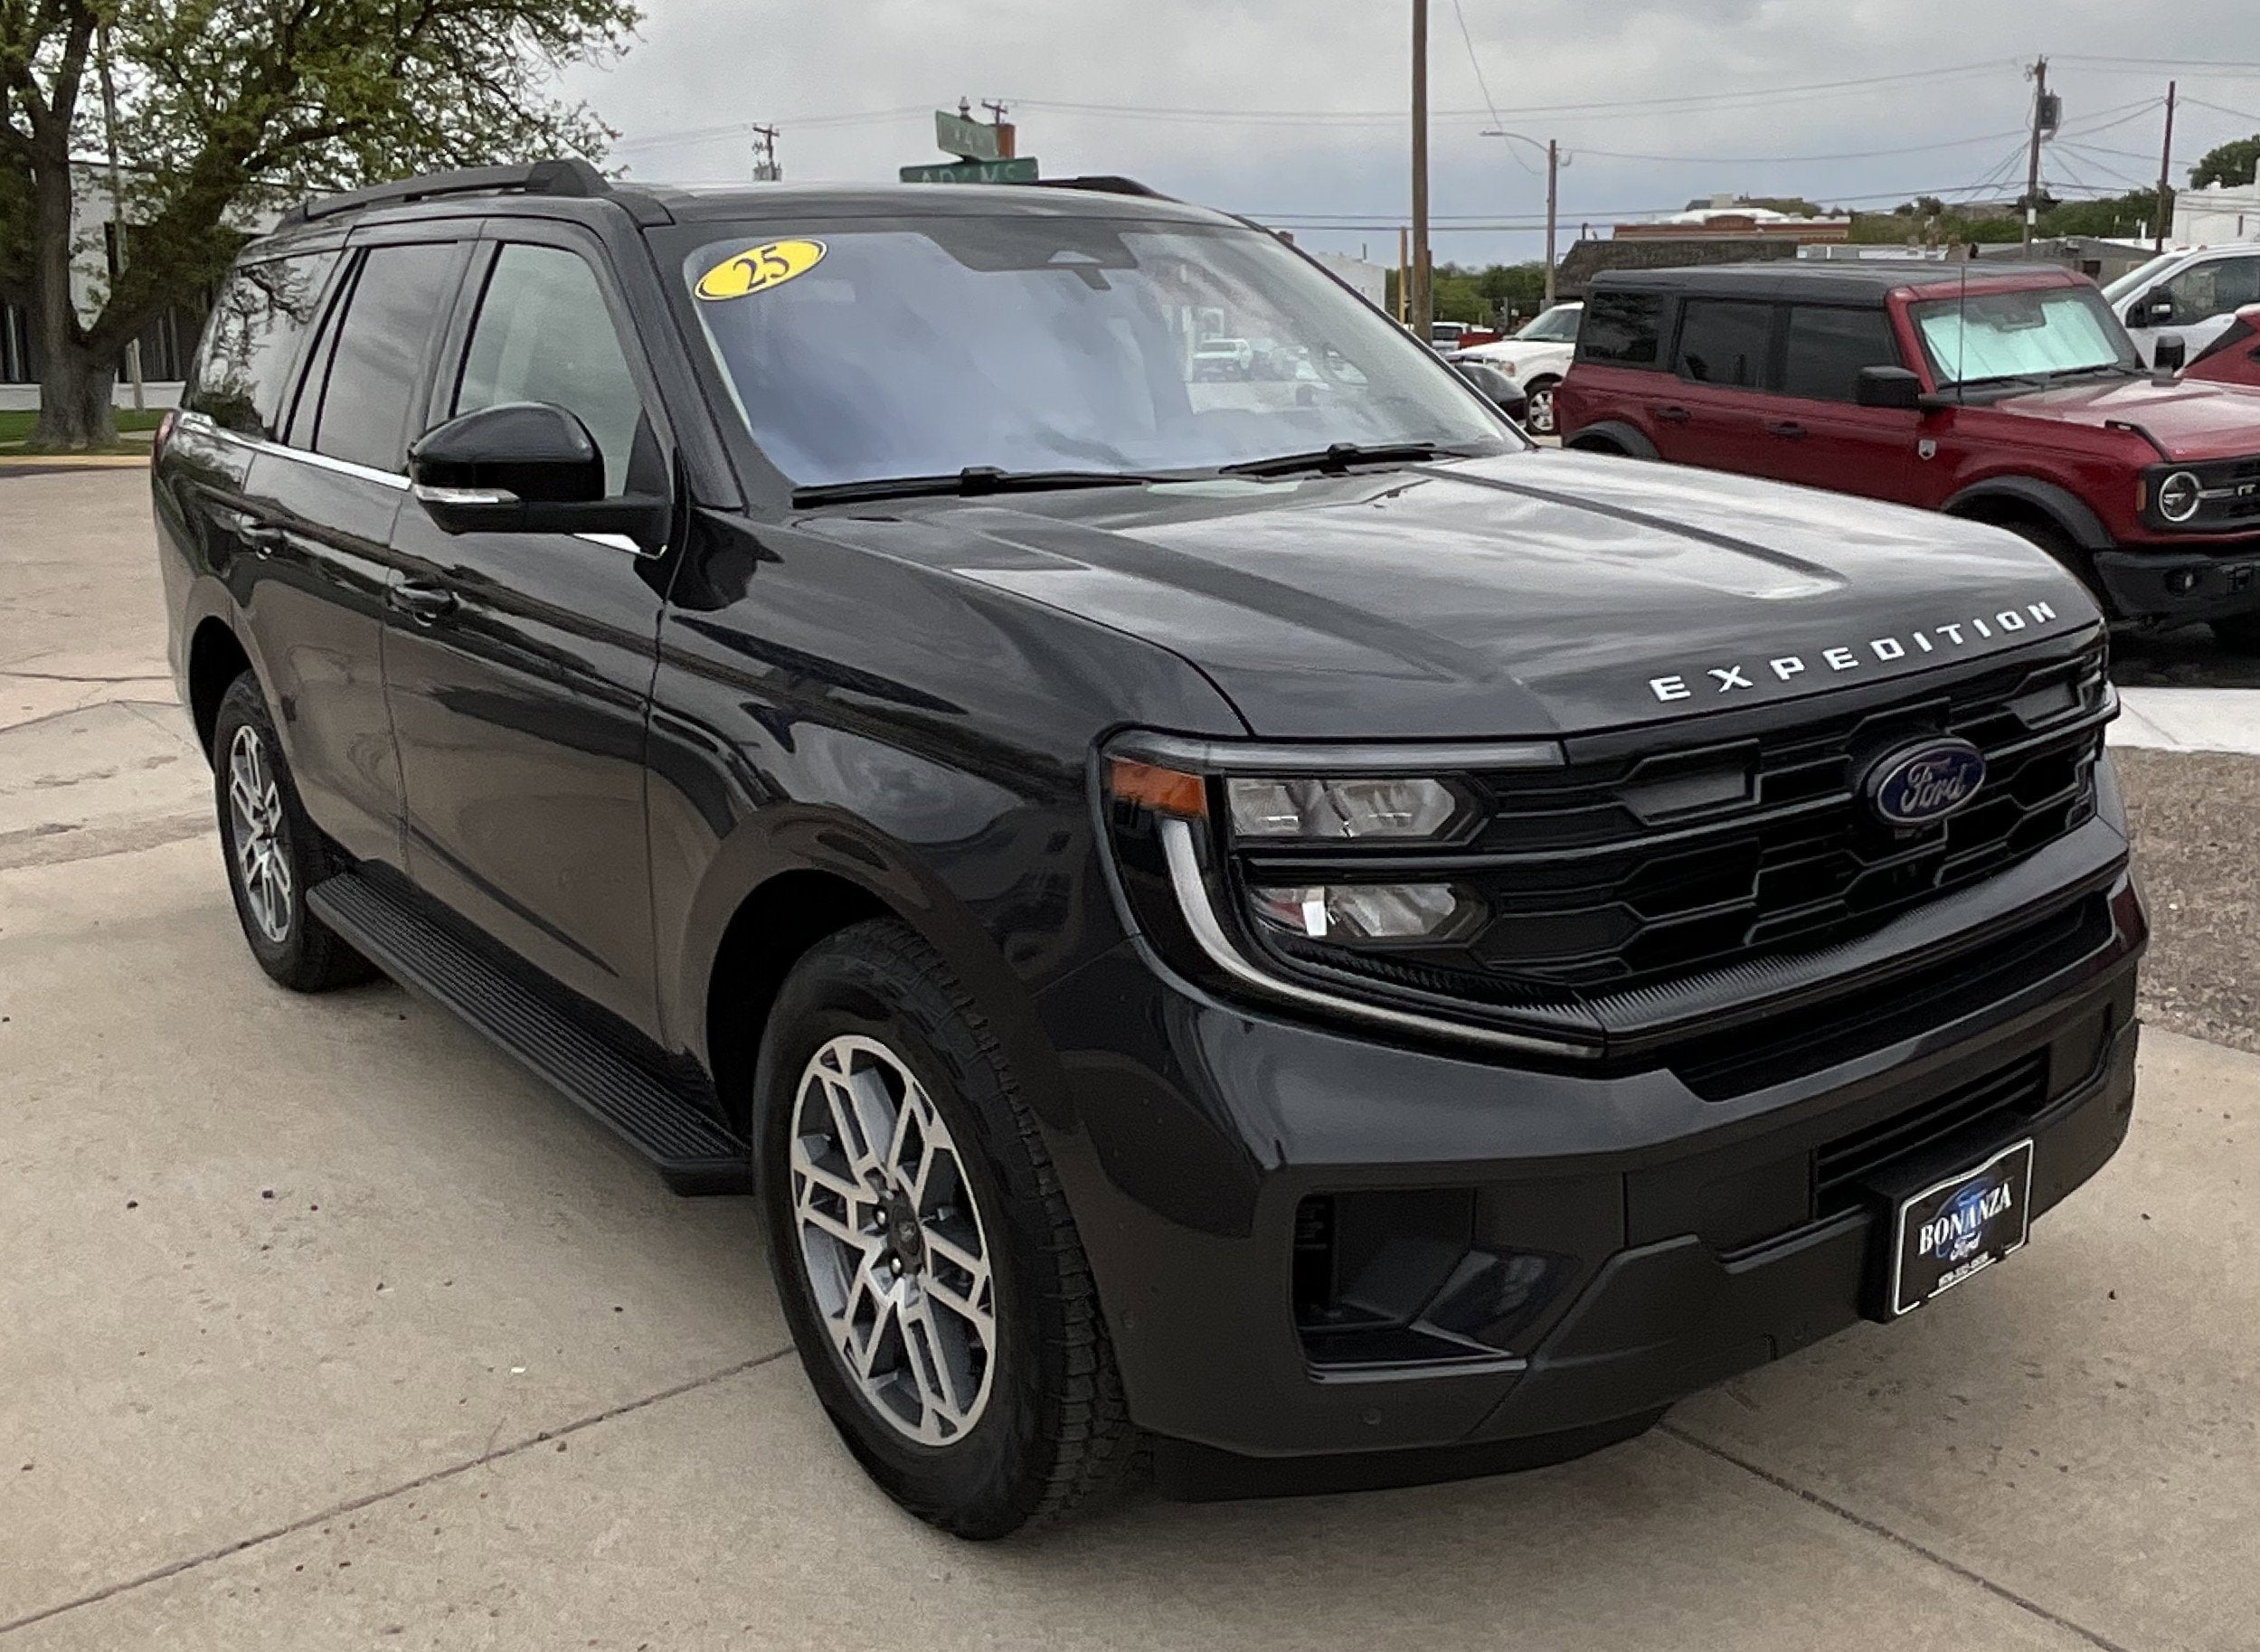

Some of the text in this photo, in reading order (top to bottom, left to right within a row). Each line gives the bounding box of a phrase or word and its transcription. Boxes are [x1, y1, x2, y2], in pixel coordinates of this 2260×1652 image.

[922, 165, 1016, 183] ADMS
[733, 245, 790, 290] 25
[1649, 600, 2057, 703] EXPEDITION
[1900, 757, 1968, 813] Ford
[1919, 1182, 2012, 1255] BONANZA
